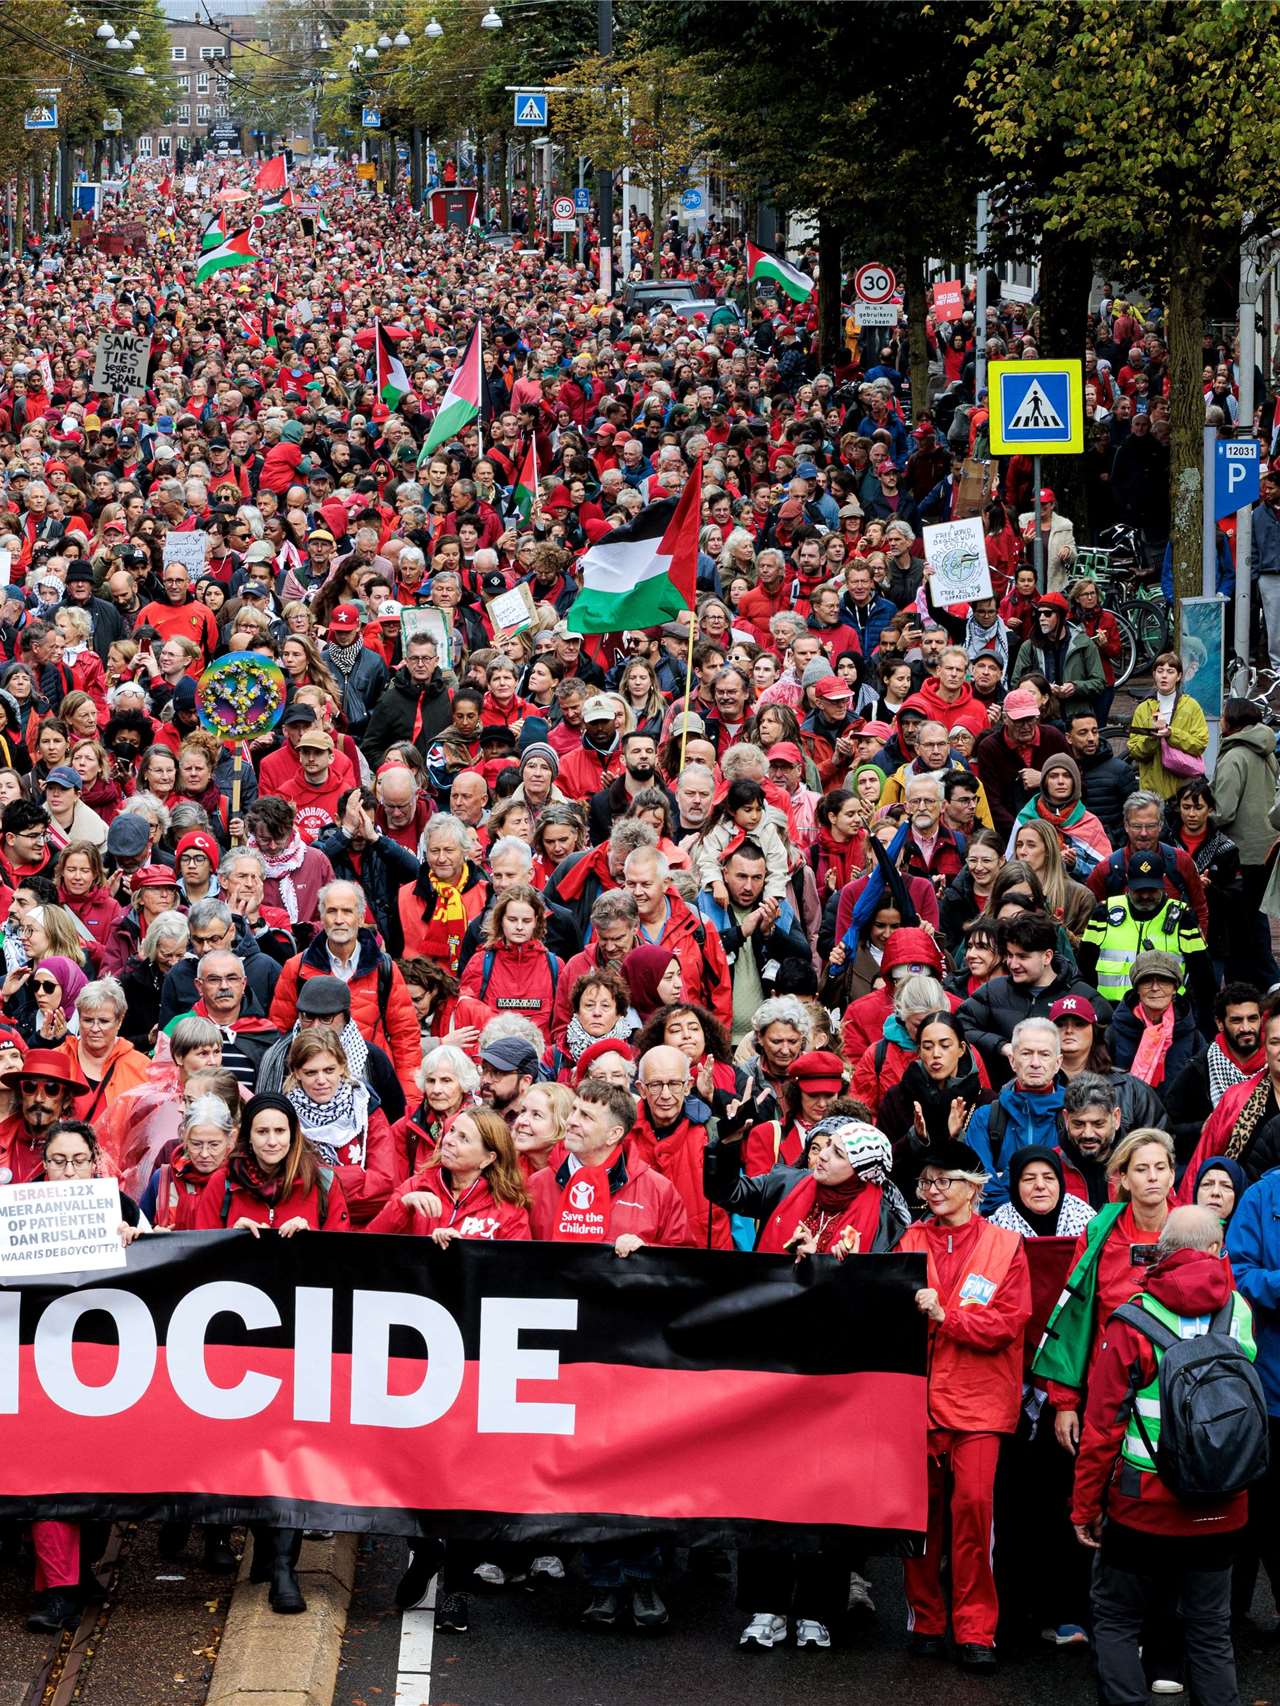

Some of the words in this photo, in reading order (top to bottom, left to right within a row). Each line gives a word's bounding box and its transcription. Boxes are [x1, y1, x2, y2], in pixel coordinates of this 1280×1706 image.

[558, 205, 570, 213] 30
[863, 276, 888, 290] 30
[103, 335, 148, 353] SANC-
[104, 351, 139, 366] TIES
[105, 363, 134, 374] tegen
[1229, 447, 1254, 455] 12031
[1229, 463, 1246, 493] P
[70, 1185, 95, 1196] 12X
[35, 1198, 113, 1213] AANVALLEN
[8, 1219, 26, 1232] OP
[30, 1211, 105, 1230] PATIËNTEN
[562, 1211, 583, 1222] Save
[586, 1212, 603, 1223] the
[559, 1223, 604, 1234] Children
[10, 1233, 39, 1246] DAN
[42, 1228, 107, 1243] RUSLAND
[1, 1250, 32, 1262] WAAR
[34, 1249, 43, 1259] IS
[45, 1248, 59, 1258] DE
